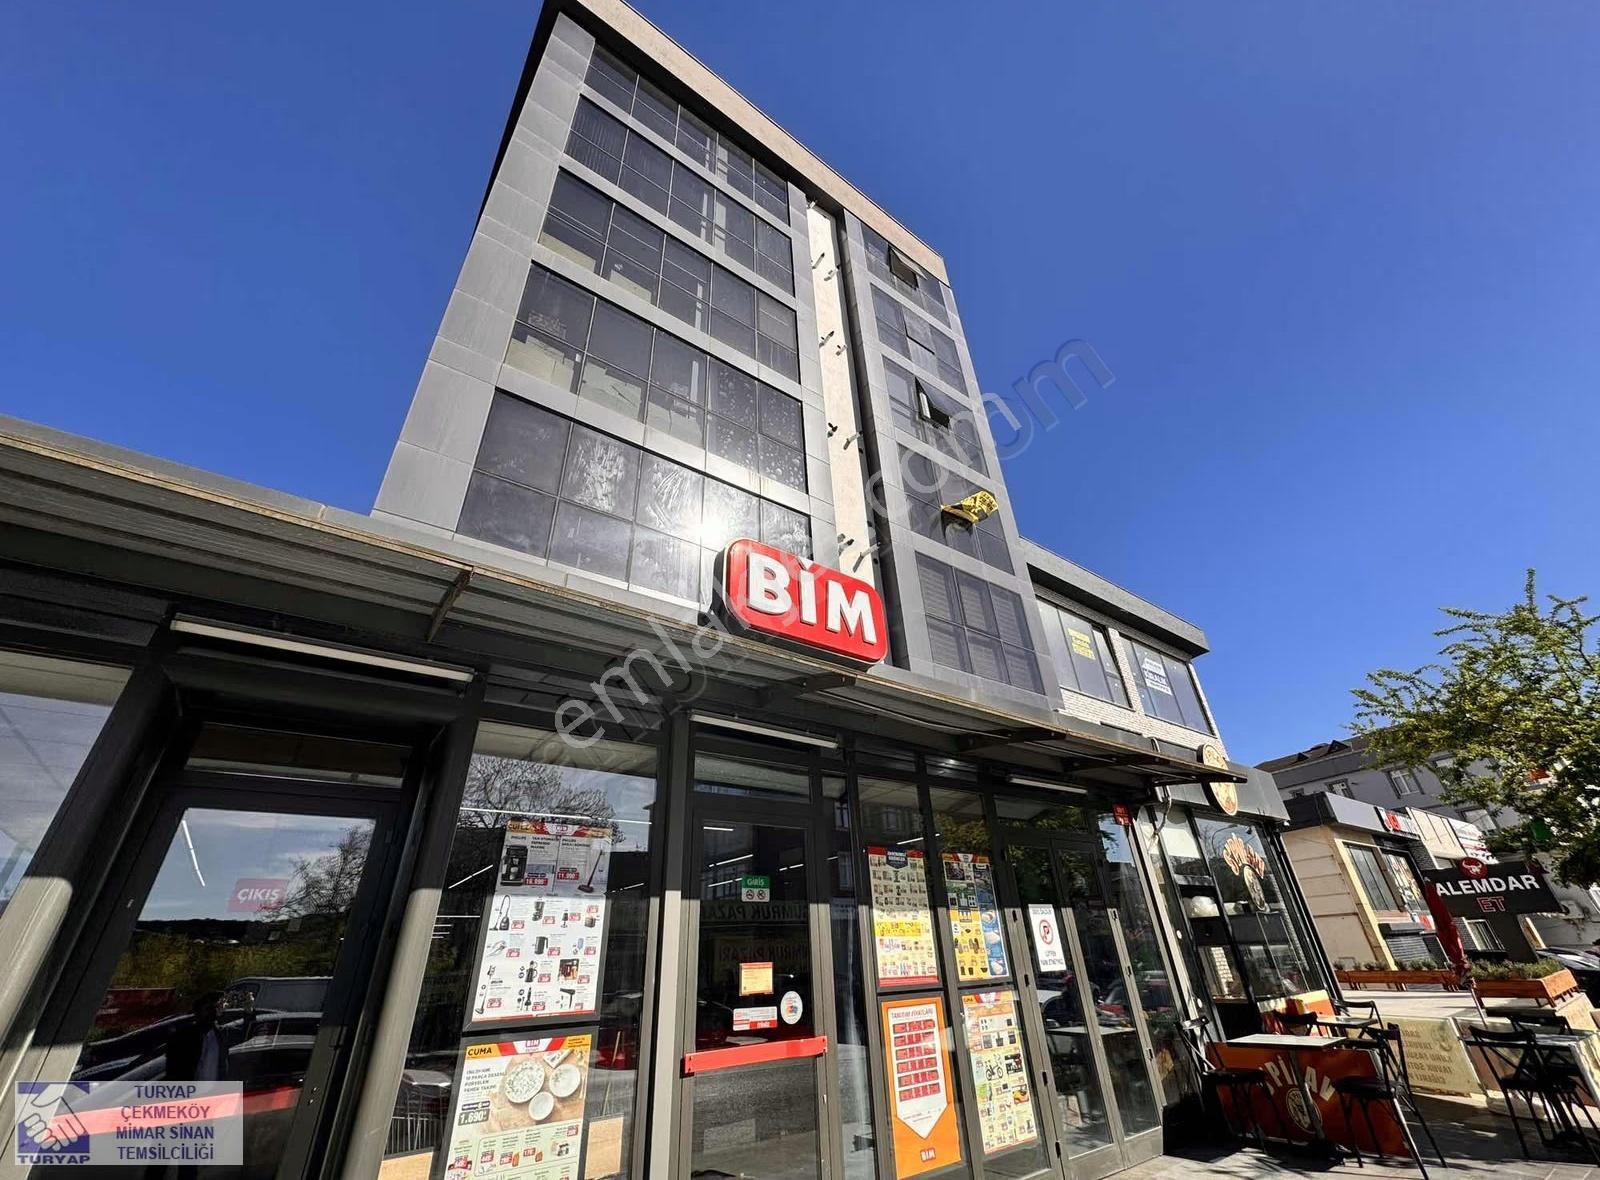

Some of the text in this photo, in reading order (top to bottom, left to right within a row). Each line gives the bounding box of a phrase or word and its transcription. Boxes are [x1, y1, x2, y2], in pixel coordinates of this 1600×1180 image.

[746, 551, 878, 645] BİM
[1436, 874, 1540, 898] ALEMDAR
[1476, 896, 1506, 912] ET
[468, 1047, 492, 1056] CUMA
